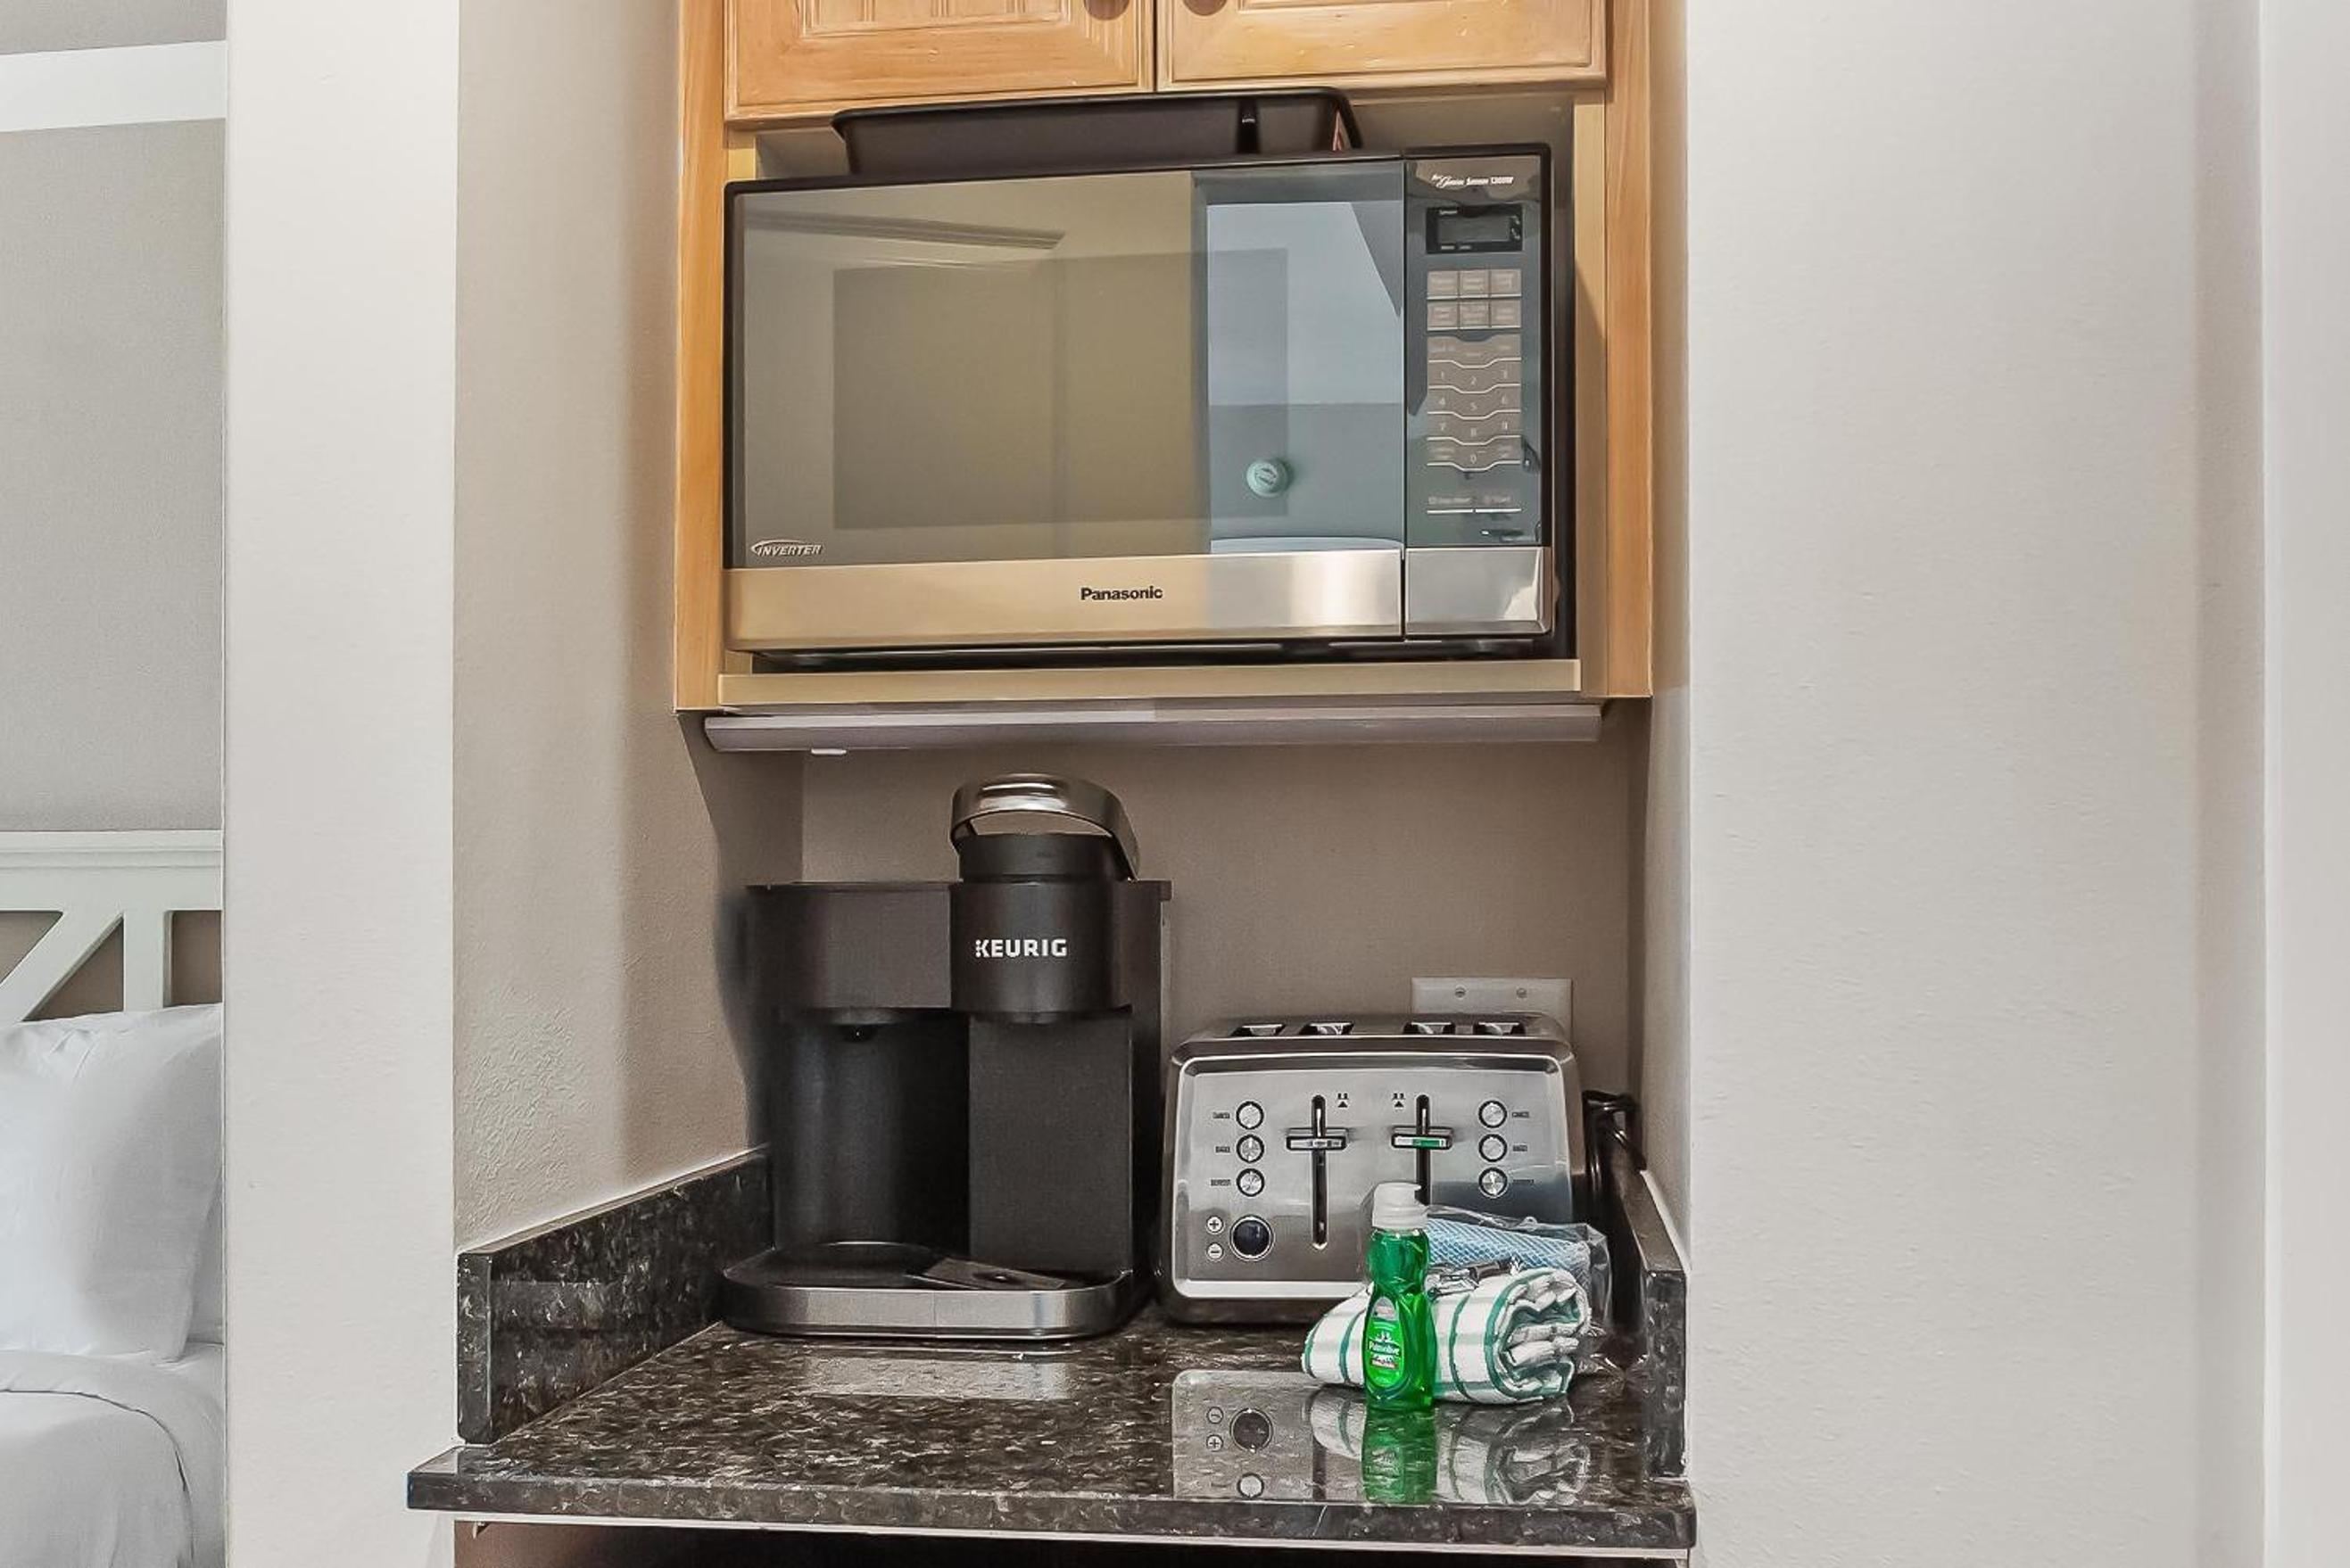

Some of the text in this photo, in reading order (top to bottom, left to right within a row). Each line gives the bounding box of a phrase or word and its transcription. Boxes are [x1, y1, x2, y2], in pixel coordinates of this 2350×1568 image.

[757, 544, 822, 557] INVERTER
[1080, 585, 1163, 600] Panasonic
[975, 939, 1068, 958] KEURIG
